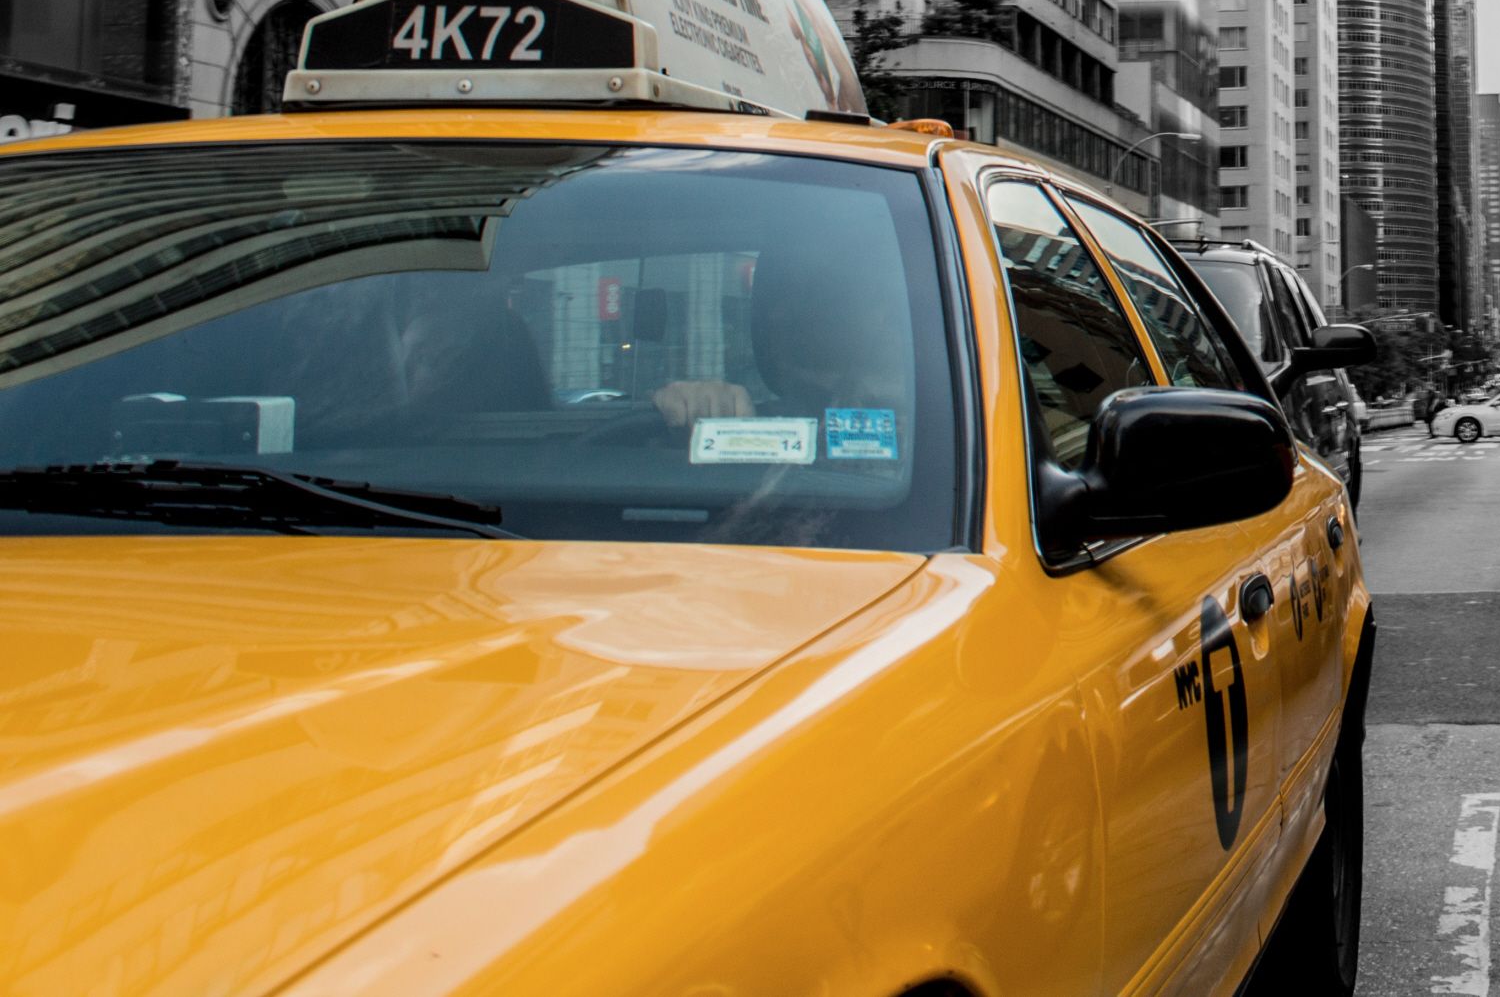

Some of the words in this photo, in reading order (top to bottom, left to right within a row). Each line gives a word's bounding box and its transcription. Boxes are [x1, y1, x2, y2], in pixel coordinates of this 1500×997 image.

[393, 5, 545, 61] 4K72
[703, 438, 715, 450] 2
[782, 439, 803, 451] 14
[1174, 660, 1201, 710] NYC
